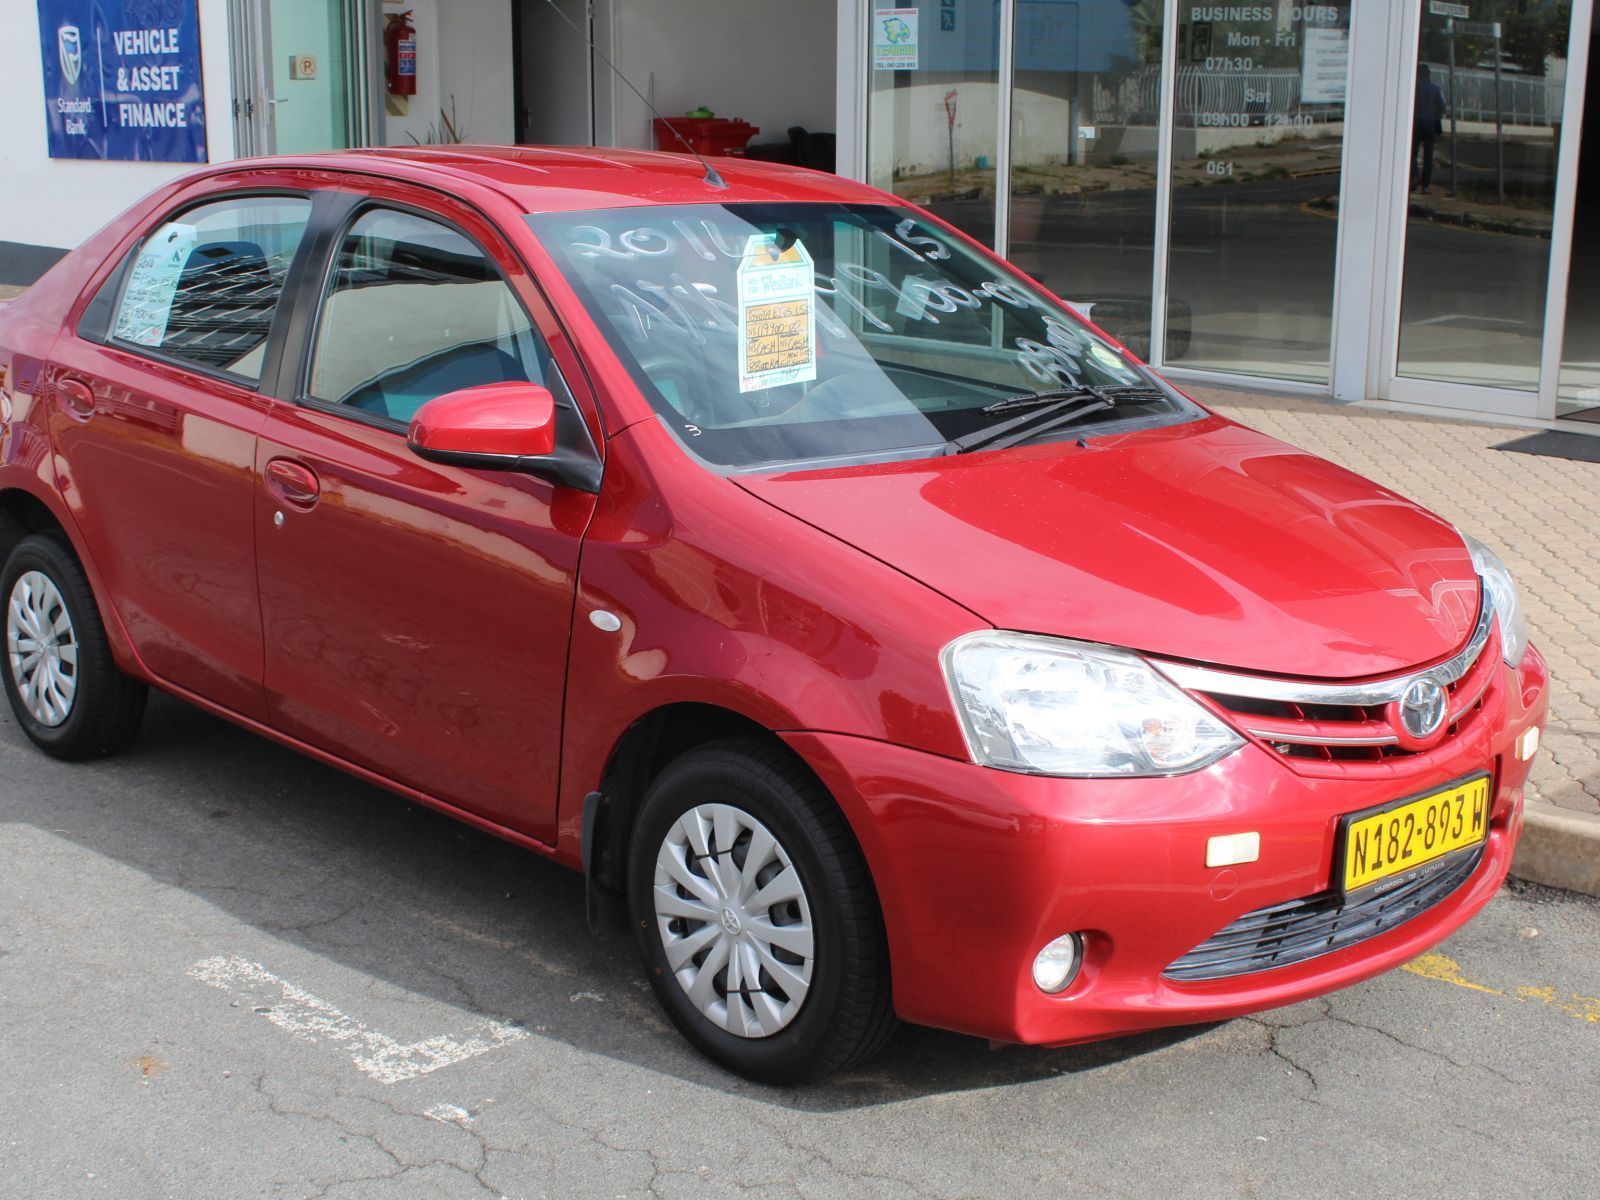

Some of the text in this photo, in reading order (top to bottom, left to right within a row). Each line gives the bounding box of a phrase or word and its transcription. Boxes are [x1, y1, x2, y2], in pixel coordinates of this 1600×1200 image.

[1191, 7, 1272, 21] BUSINESS
[113, 28, 179, 55] VEHICLE
[1227, 32, 1261, 47] Mon
[1275, 32, 1296, 47] Fri
[1205, 57, 1252, 71] 07h30
[117, 66, 180, 91] & ASSET
[57, 97, 91, 113] Standard
[119, 103, 187, 127] FINANCE
[66, 119, 86, 134] Bank
[1206, 161, 1233, 175] 061
[1353, 786, 1485, 878] N182-893 W
